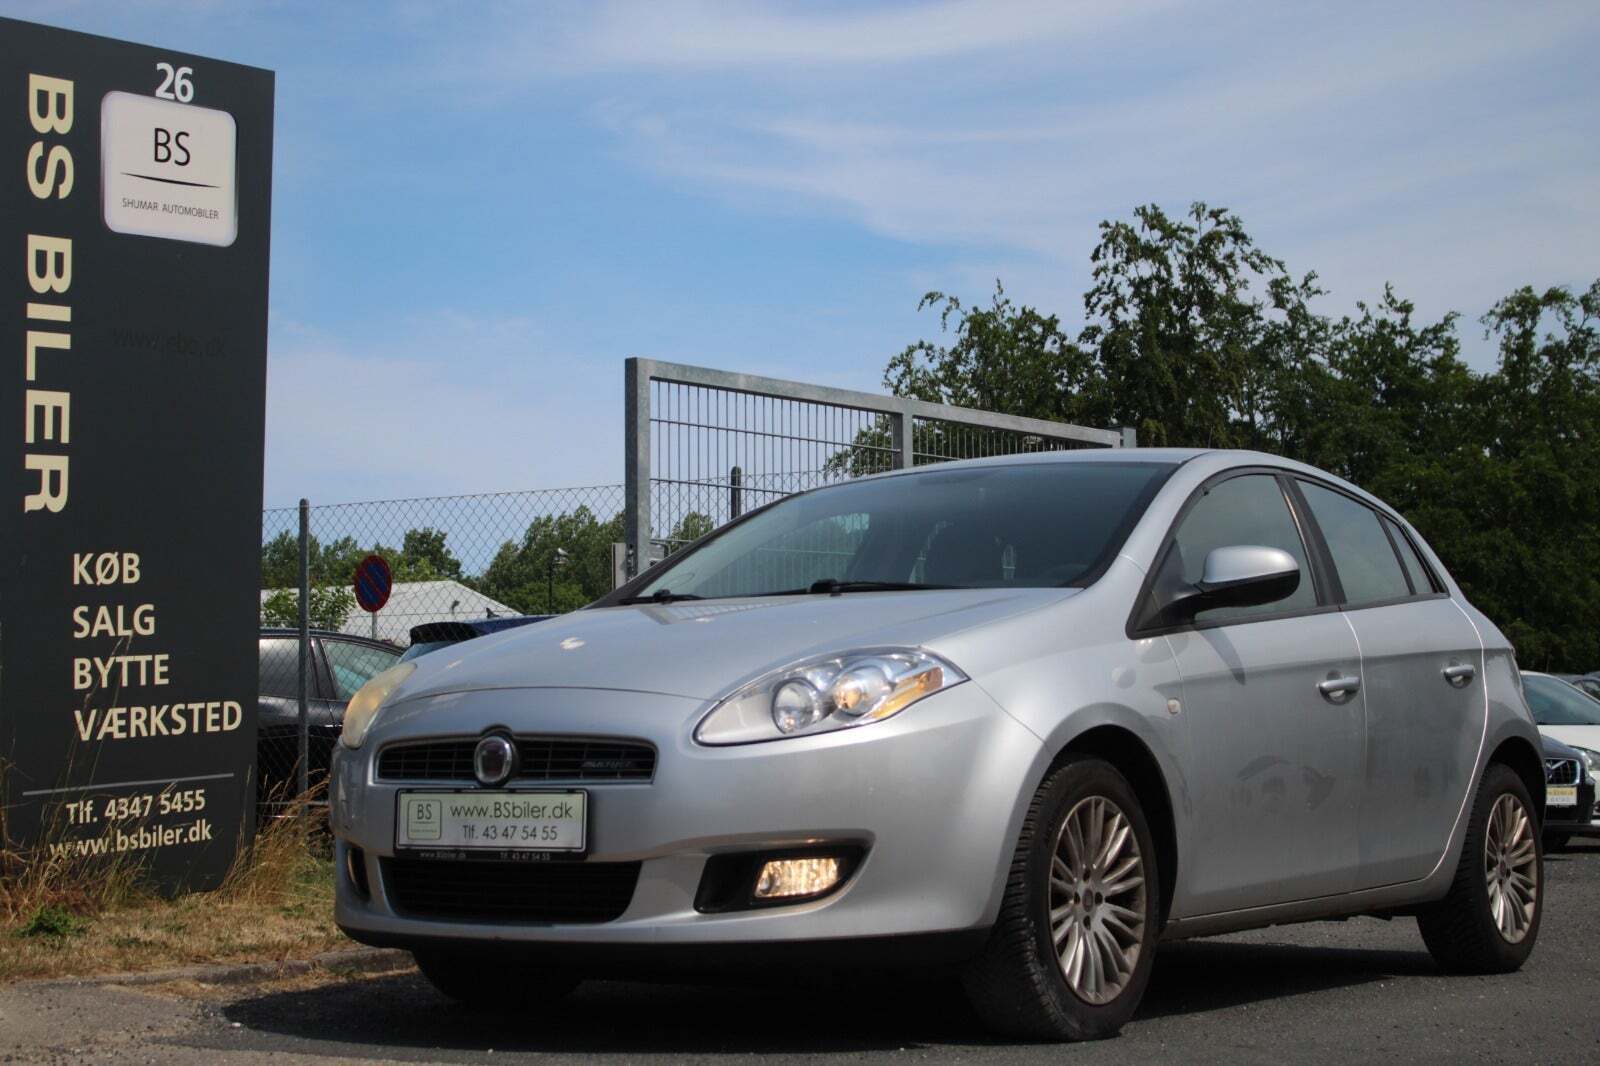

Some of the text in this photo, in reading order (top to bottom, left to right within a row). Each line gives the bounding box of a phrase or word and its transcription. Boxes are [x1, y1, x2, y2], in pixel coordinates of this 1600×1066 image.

[155, 62, 194, 103] 26
[154, 127, 190, 166] BS
[122, 198, 219, 219] SHUMAR AUTOMOBILER
[24, 73, 74, 513] BS BILER
[72, 551, 141, 586] KØB
[73, 604, 155, 638] SALG
[74, 654, 169, 690] BYTTE
[74, 701, 242, 741] VÆRKSTED
[66, 789, 206, 825] Tlf. 4347 5455
[417, 804, 432, 820] BS
[450, 801, 572, 819] www.BSbiler.dk
[463, 825, 557, 840] Tlf. 43 47 54 55
